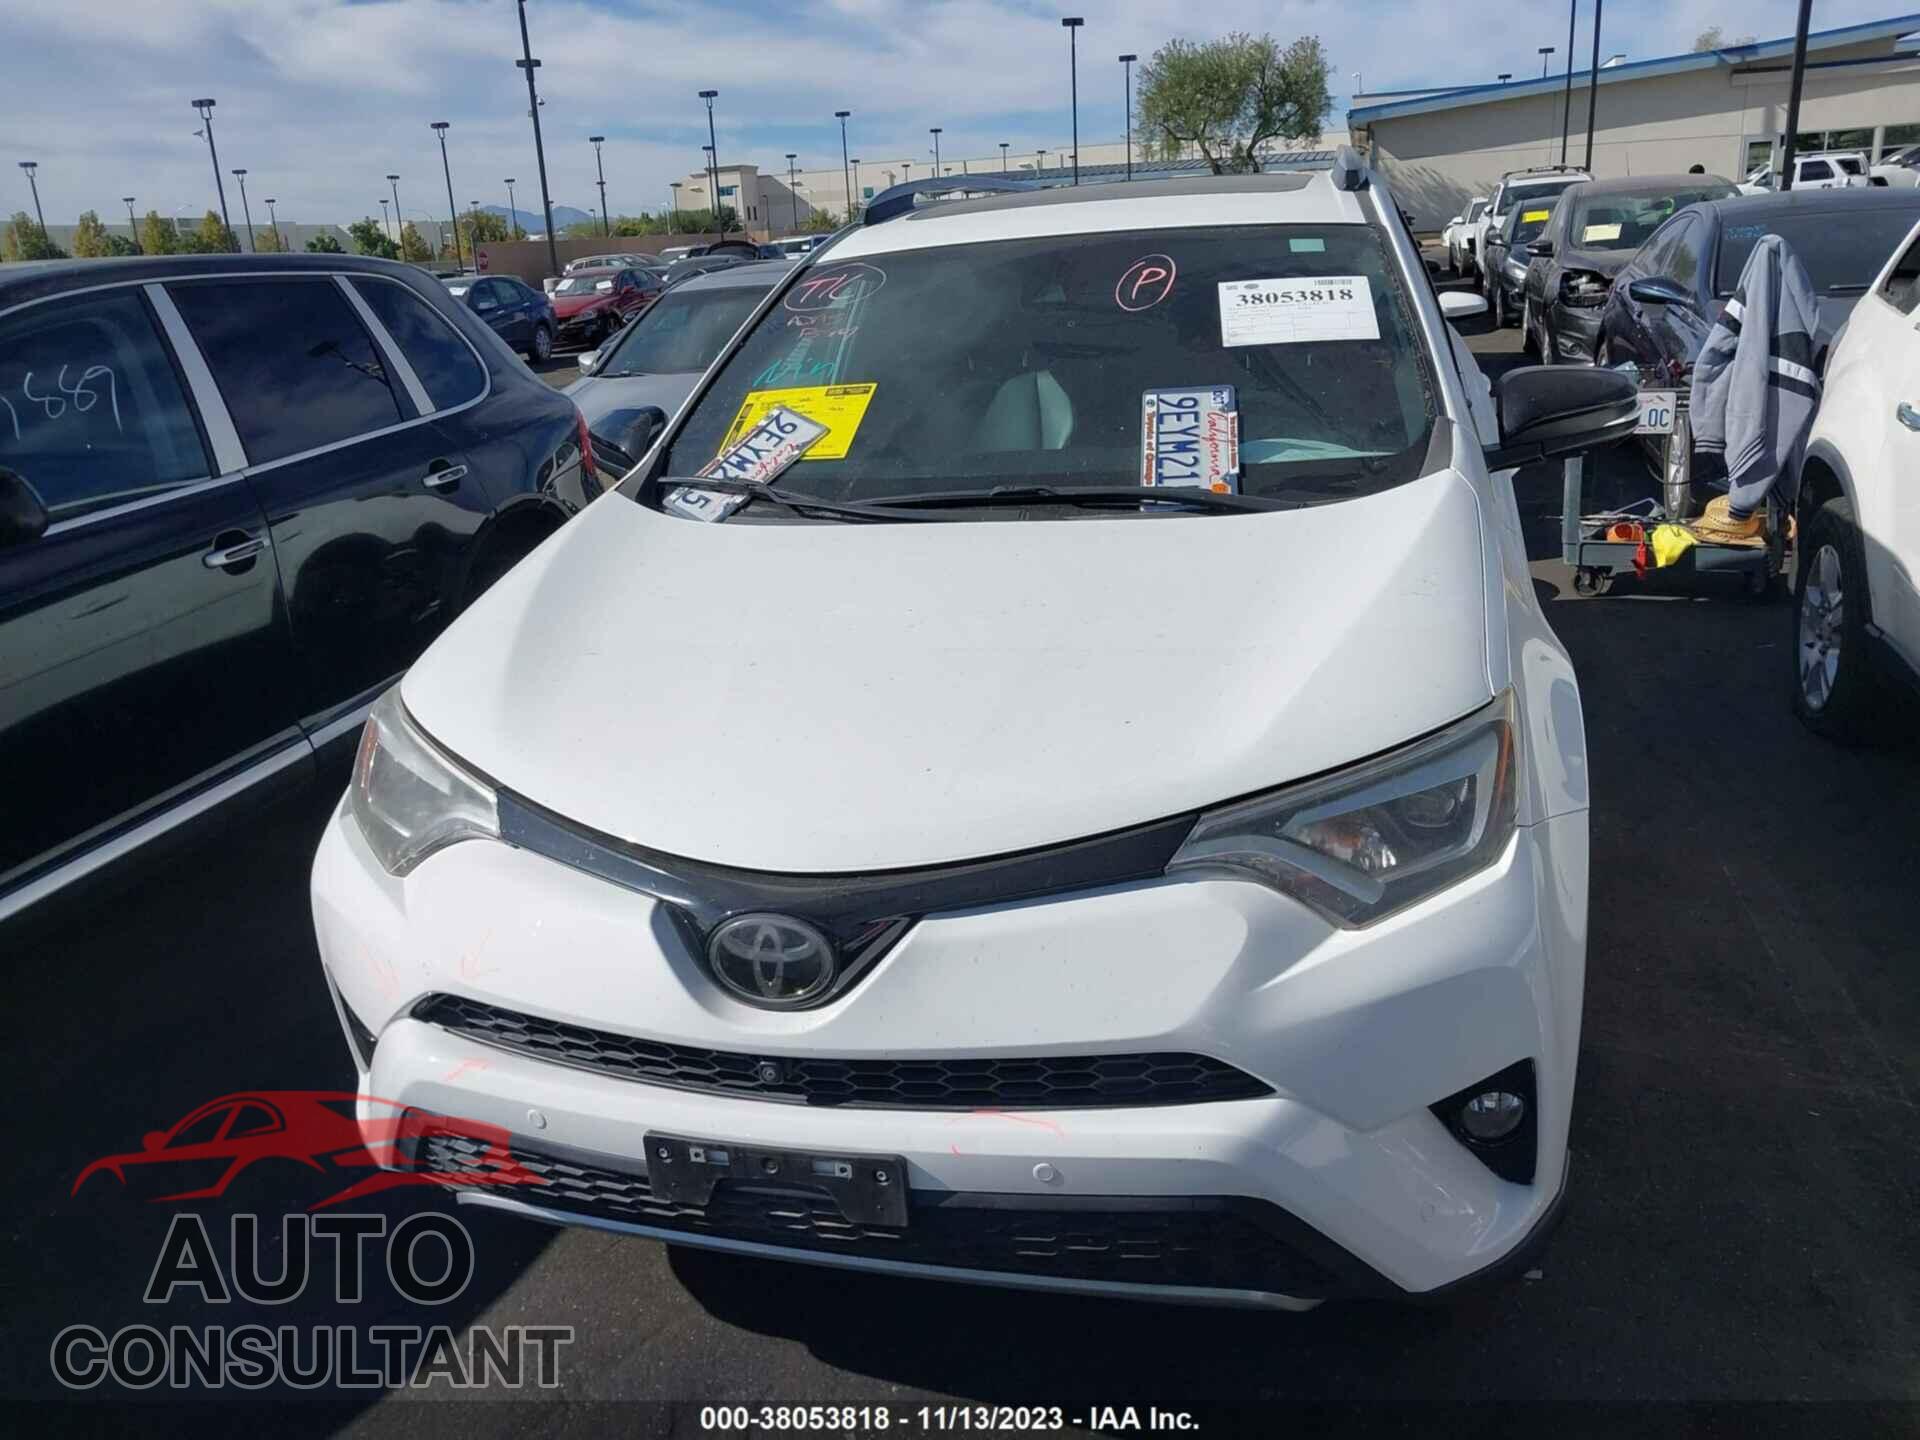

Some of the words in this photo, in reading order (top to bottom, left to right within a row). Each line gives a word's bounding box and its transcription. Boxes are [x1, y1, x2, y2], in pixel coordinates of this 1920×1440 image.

[1131, 266, 1168, 300] P
[1235, 288, 1354, 308] 38053818
[681, 411, 798, 510] 9EYM25
[1157, 397, 1200, 487] 9EYM21
